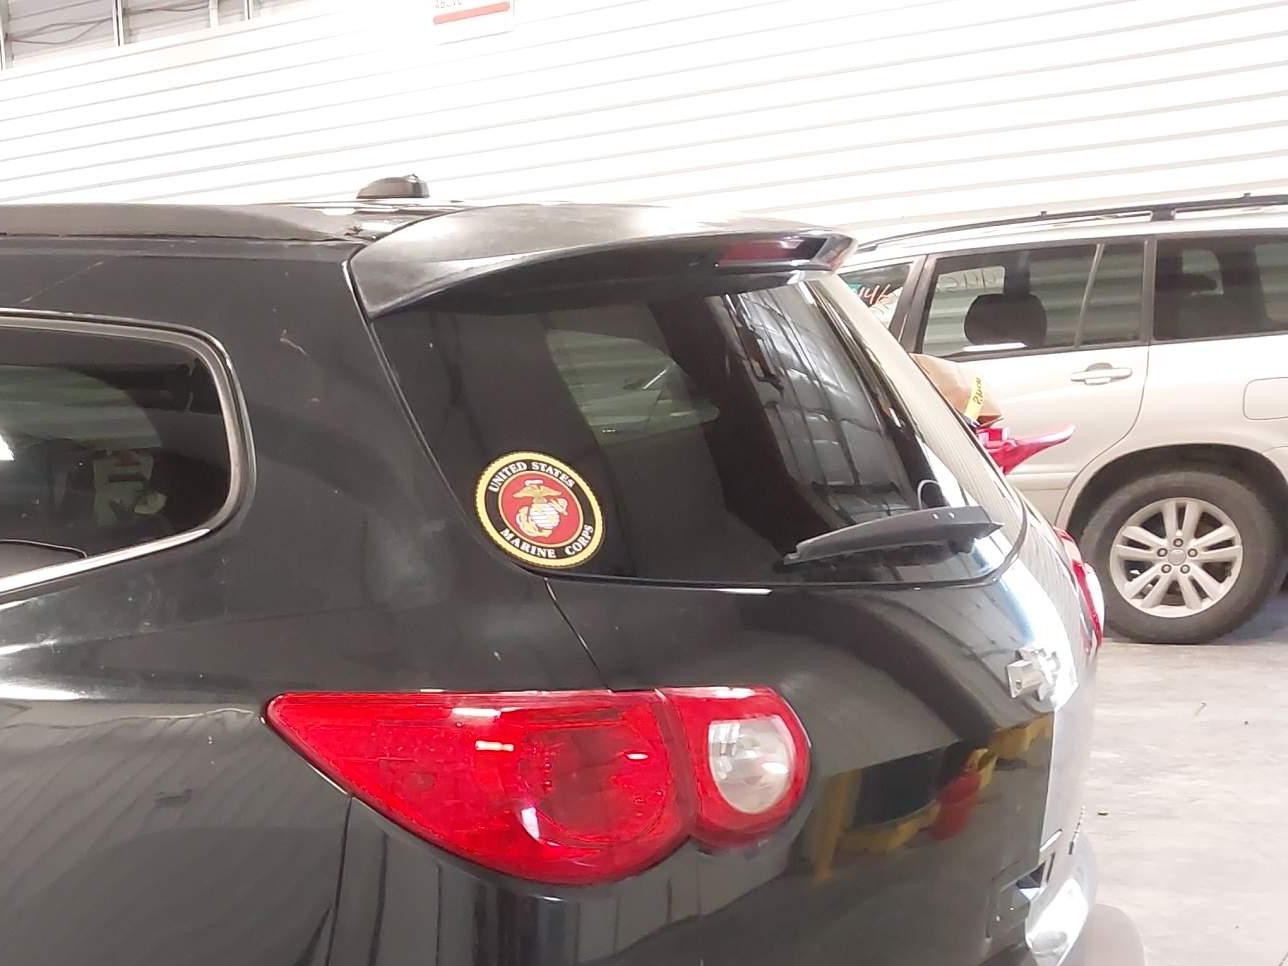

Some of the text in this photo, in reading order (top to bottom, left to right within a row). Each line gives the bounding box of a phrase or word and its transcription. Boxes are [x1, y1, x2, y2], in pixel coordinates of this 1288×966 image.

[488, 461, 575, 494] UNITED STATES
[500, 523, 594, 559] MARINE CORPS
